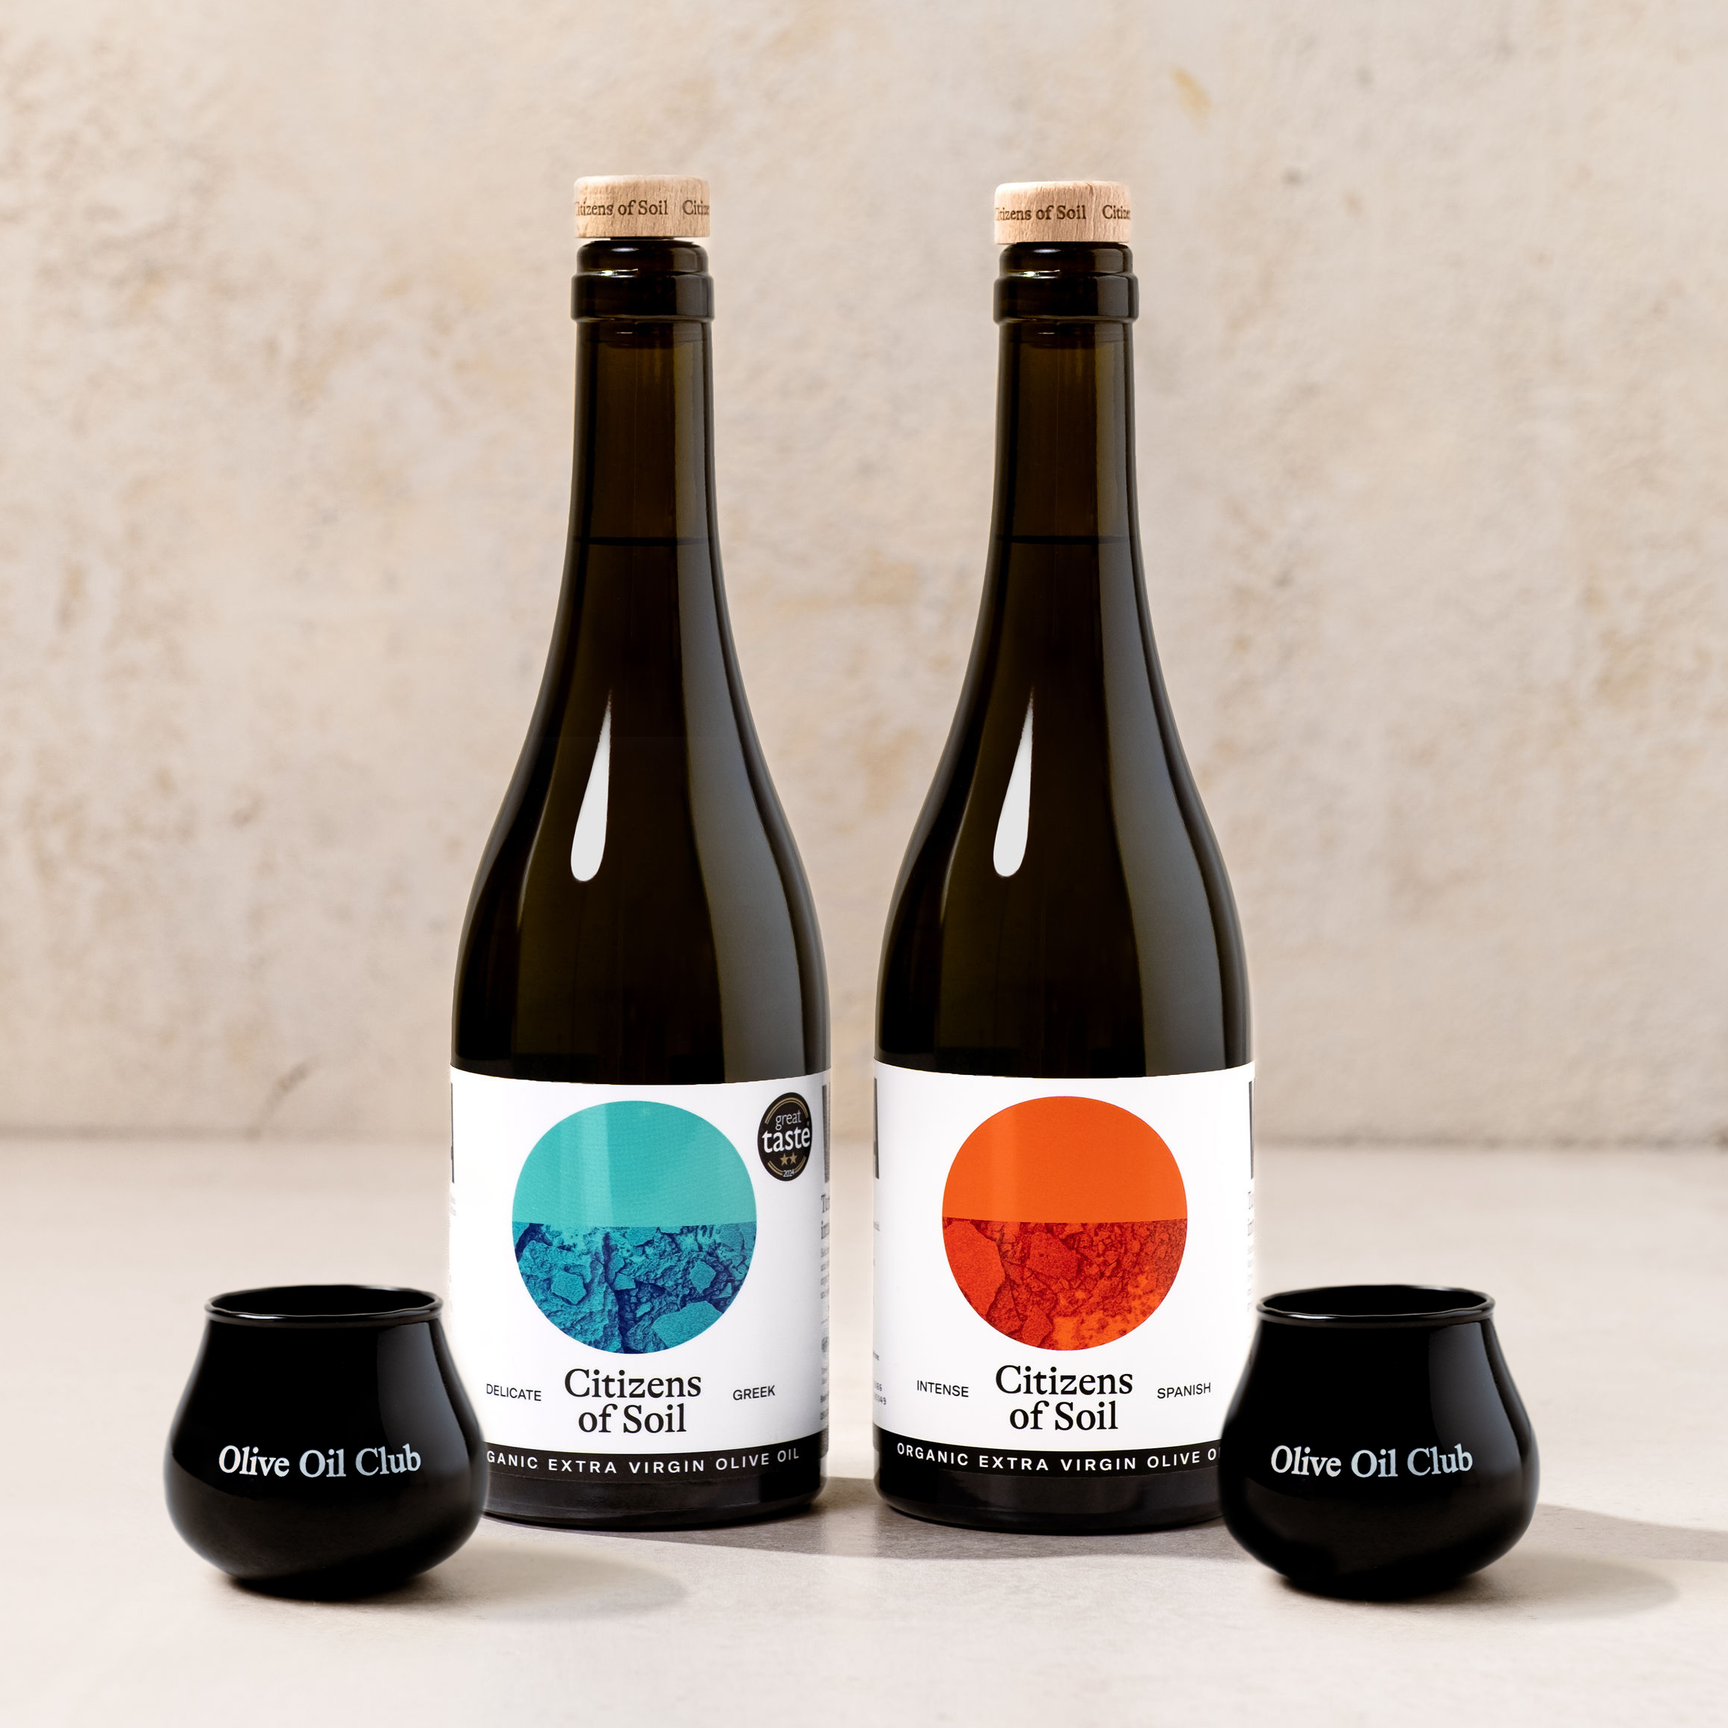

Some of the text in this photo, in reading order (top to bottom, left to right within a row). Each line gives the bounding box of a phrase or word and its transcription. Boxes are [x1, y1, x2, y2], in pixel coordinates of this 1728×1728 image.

[575, 199, 668, 216] itizens of Soil
[996, 204, 1087, 221] itizens of Soil
[775, 1109, 802, 1131] great
[761, 1126, 811, 1154] taste
[486, 1383, 542, 1402] DELICATE
[564, 1367, 702, 1399] Citizens
[732, 1385, 776, 1401] GREEK
[916, 1379, 970, 1398] INTENSE
[995, 1364, 1134, 1395] Citizens
[1156, 1382, 1212, 1400] SPANISH
[578, 1402, 687, 1434] of Soil
[1009, 1400, 1119, 1431] of Soil
[218, 1442, 422, 1478] Olive Oil Club
[548, 1458, 617, 1474] EXTRA
[628, 1459, 705, 1474] VIRGIN
[715, 1452, 770, 1471] OLIVE
[777, 1447, 800, 1463] OIL
[896, 1442, 969, 1466] ORGANIC
[978, 1455, 1049, 1471] EXTRA
[1060, 1457, 1136, 1472] VIRGIN
[1146, 1450, 1201, 1469] OLIVE
[1270, 1442, 1474, 1478] Olive Oil Club
